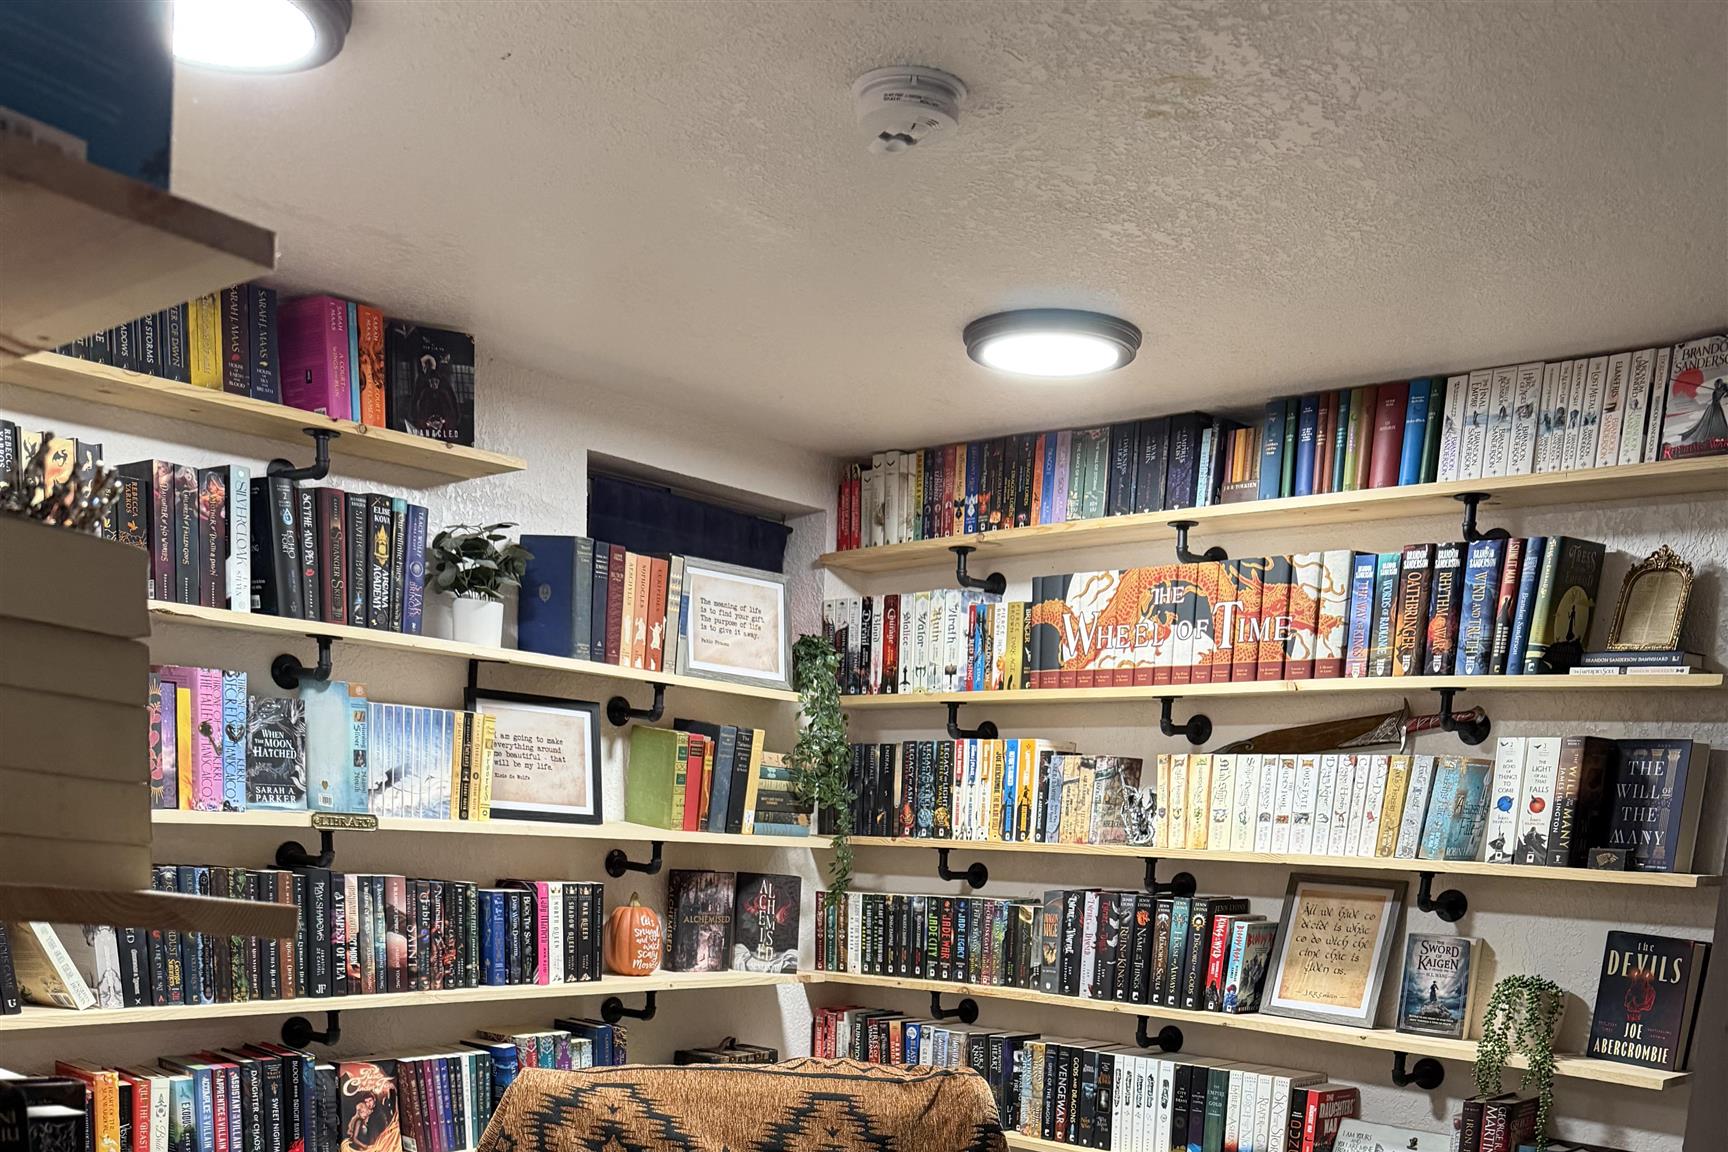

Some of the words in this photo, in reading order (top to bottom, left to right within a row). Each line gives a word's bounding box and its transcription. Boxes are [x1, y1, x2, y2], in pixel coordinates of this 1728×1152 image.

[257, 331, 267, 363] MAAS
[1441, 431, 1453, 477] SANDERSON
[1463, 427, 1476, 472] SANDERSON
[1470, 431, 1481, 466] BRANDON
[1488, 424, 1500, 469] SANDERSON
[1495, 428, 1507, 469] BRANDON
[1511, 422, 1524, 467] SANDERSON
[1517, 425, 1530, 462] BRANDON
[302, 493, 314, 529] SCYTHE
[1403, 558, 1429, 570] SANDERSON
[1405, 550, 1428, 561] BRANDON
[372, 564, 383, 612] ACADEMY
[382, 569, 391, 608] ARCANA
[1151, 585, 1186, 607] THE
[1438, 571, 1453, 617] RHYTHM
[1472, 571, 1488, 602] WIND
[700, 597, 712, 606] The
[713, 600, 738, 611] meaning
[739, 602, 748, 610] of
[749, 604, 762, 615] life
[700, 607, 708, 615] is
[709, 608, 717, 616] to
[718, 609, 733, 619] find
[734, 614, 750, 624] your
[1401, 571, 1423, 652] OATHBRINGER
[700, 615, 712, 623] The
[713, 618, 738, 629] purpose
[739, 620, 748, 629] of
[749, 622, 762, 632] life
[701, 624, 708, 632] is
[709, 626, 717, 634] to
[718, 627, 733, 638] give
[734, 628, 742, 636] it
[1024, 608, 1032, 645] BRINGER
[1062, 610, 1165, 659] WHEEL
[1175, 617, 1211, 641] OF
[1211, 599, 1294, 651] TIME
[1465, 618, 1482, 655] TRUTH
[1432, 627, 1445, 654] WAR
[261, 729, 286, 740] WHEN
[264, 739, 295, 751] MOON
[500, 733, 511, 741] am
[512, 734, 533, 745] going
[536, 736, 545, 744] to
[546, 737, 564, 746] make
[252, 745, 298, 760] HATCHED
[493, 741, 534, 753] everything
[536, 744, 562, 755] around
[505, 749, 542, 762] beautiful
[550, 754, 567, 764] that
[493, 757, 511, 767] will
[513, 760, 522, 769] be
[524, 763, 534, 772] my
[1531, 765, 1552, 774] LIGHT
[1628, 759, 1665, 777] THE
[255, 785, 286, 796] SARAH
[1529, 785, 1550, 794] FALLS
[1559, 768, 1567, 789] JAMES
[1565, 766, 1578, 799] WILL
[1616, 782, 1660, 800] WILL
[1661, 786, 1673, 796] OF
[255, 793, 297, 804] PARKER
[1552, 790, 1564, 834] ISLINGTON
[1621, 805, 1657, 823] THE
[1558, 807, 1573, 850] MANY
[1608, 828, 1665, 848] MANY
[419, 892, 431, 927] Fable
[567, 901, 576, 929] SHADOW
[1192, 905, 1209, 914] LYONS
[1193, 900, 1208, 908] JENN
[683, 913, 731, 926] ALCHEMISED
[407, 925, 418, 968] SAINT
[1120, 926, 1130, 947] RUIN
[1135, 928, 1146, 953] NAME
[1420, 940, 1460, 957] SWORD
[1637, 941, 1655, 953] the
[1116, 957, 1130, 992] KINGS
[1132, 960, 1145, 990] THINGS
[1416, 954, 1460, 972] KAIGEN
[1607, 949, 1684, 985] DEVILS
[1623, 1021, 1644, 1040] JOE
[1593, 1036, 1671, 1065] ABERCROMBIE
[250, 1070, 259, 1113] DAUGHTER
[1057, 1063, 1068, 1125] VENGEWAR
[271, 1098, 280, 1117] SWEET
[1070, 1089, 1079, 1125] DRAGONS
[251, 1121, 261, 1151] CHAOS
[1496, 1105, 1507, 1142] GEORGE
